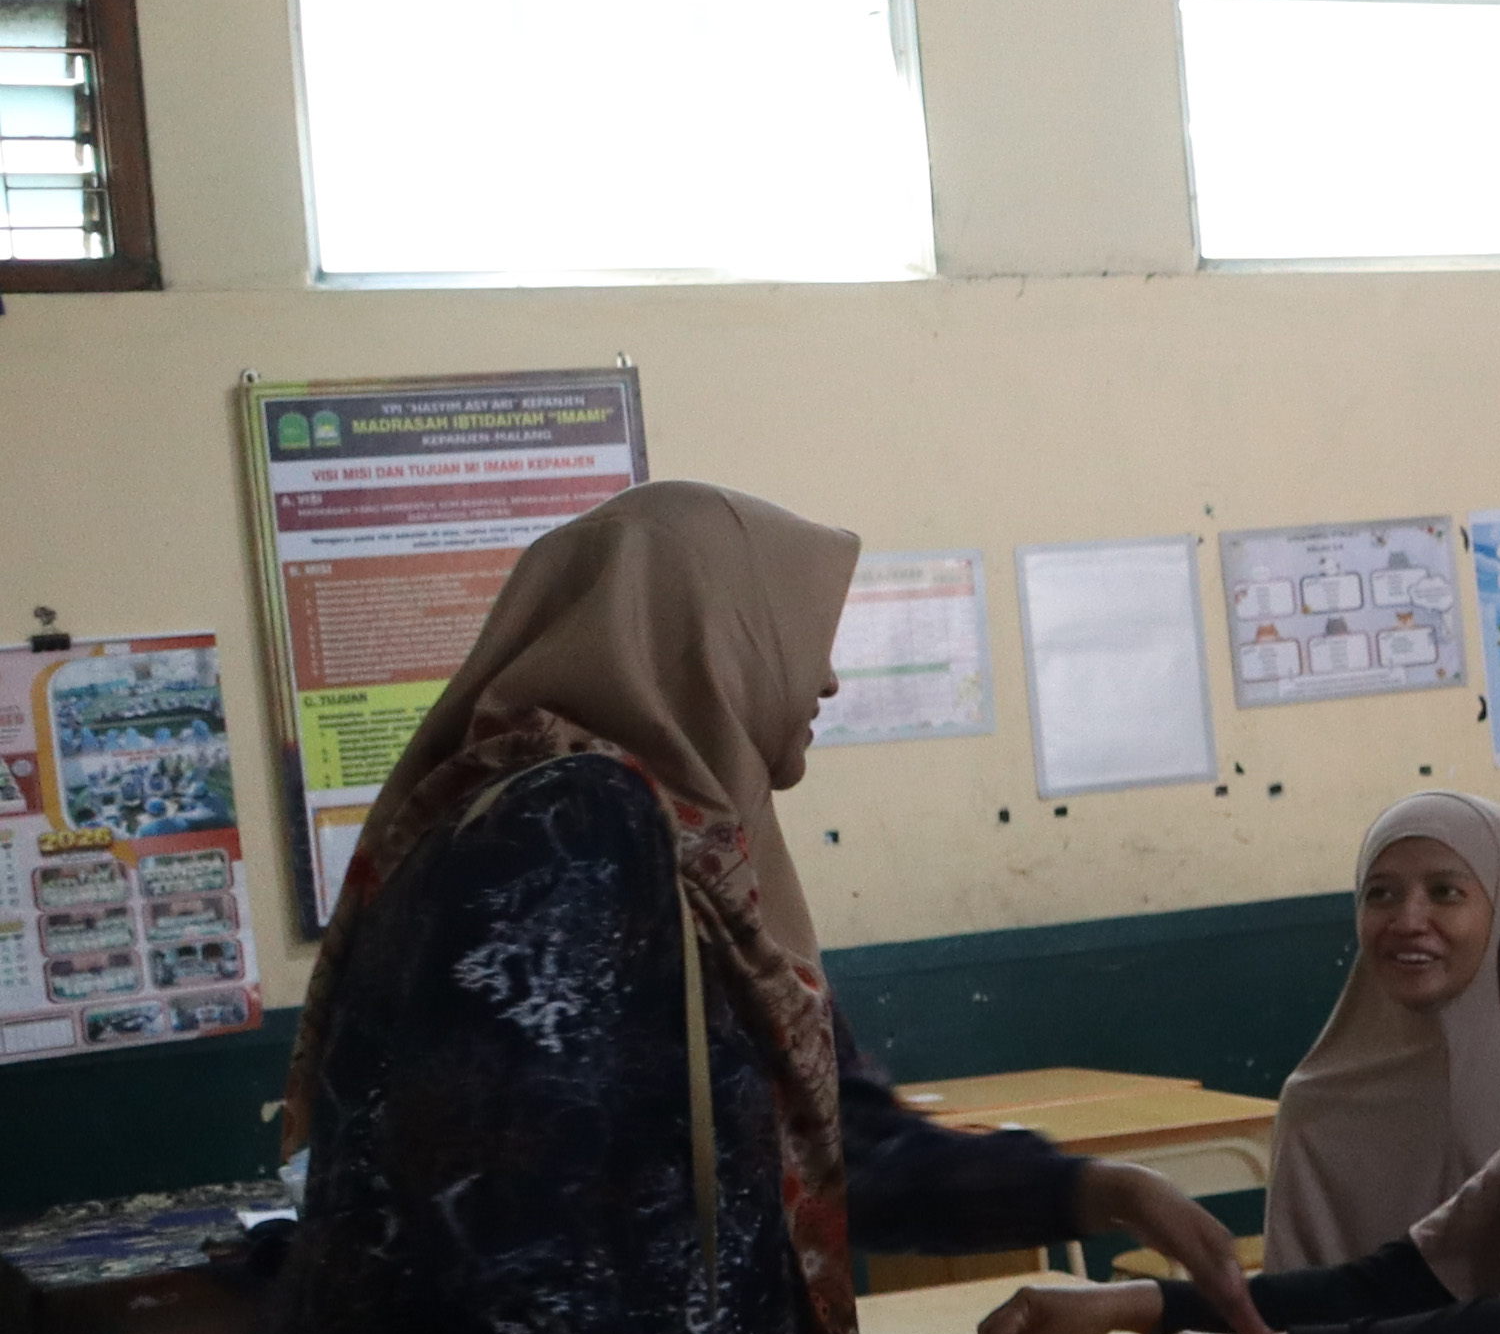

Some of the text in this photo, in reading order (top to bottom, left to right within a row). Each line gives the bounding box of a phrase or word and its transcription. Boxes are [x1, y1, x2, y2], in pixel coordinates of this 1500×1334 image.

[352, 416, 449, 434] MADRASAH
[453, 411, 545, 429] IBTIDAIYAH
[312, 468, 339, 481] VISI
[343, 467, 372, 480] MISI
[375, 465, 404, 478] DAN
[407, 463, 459, 477] TUJUAN
[527, 456, 595, 470] KEPANJEN
[320, 693, 368, 706] TUJUAN
